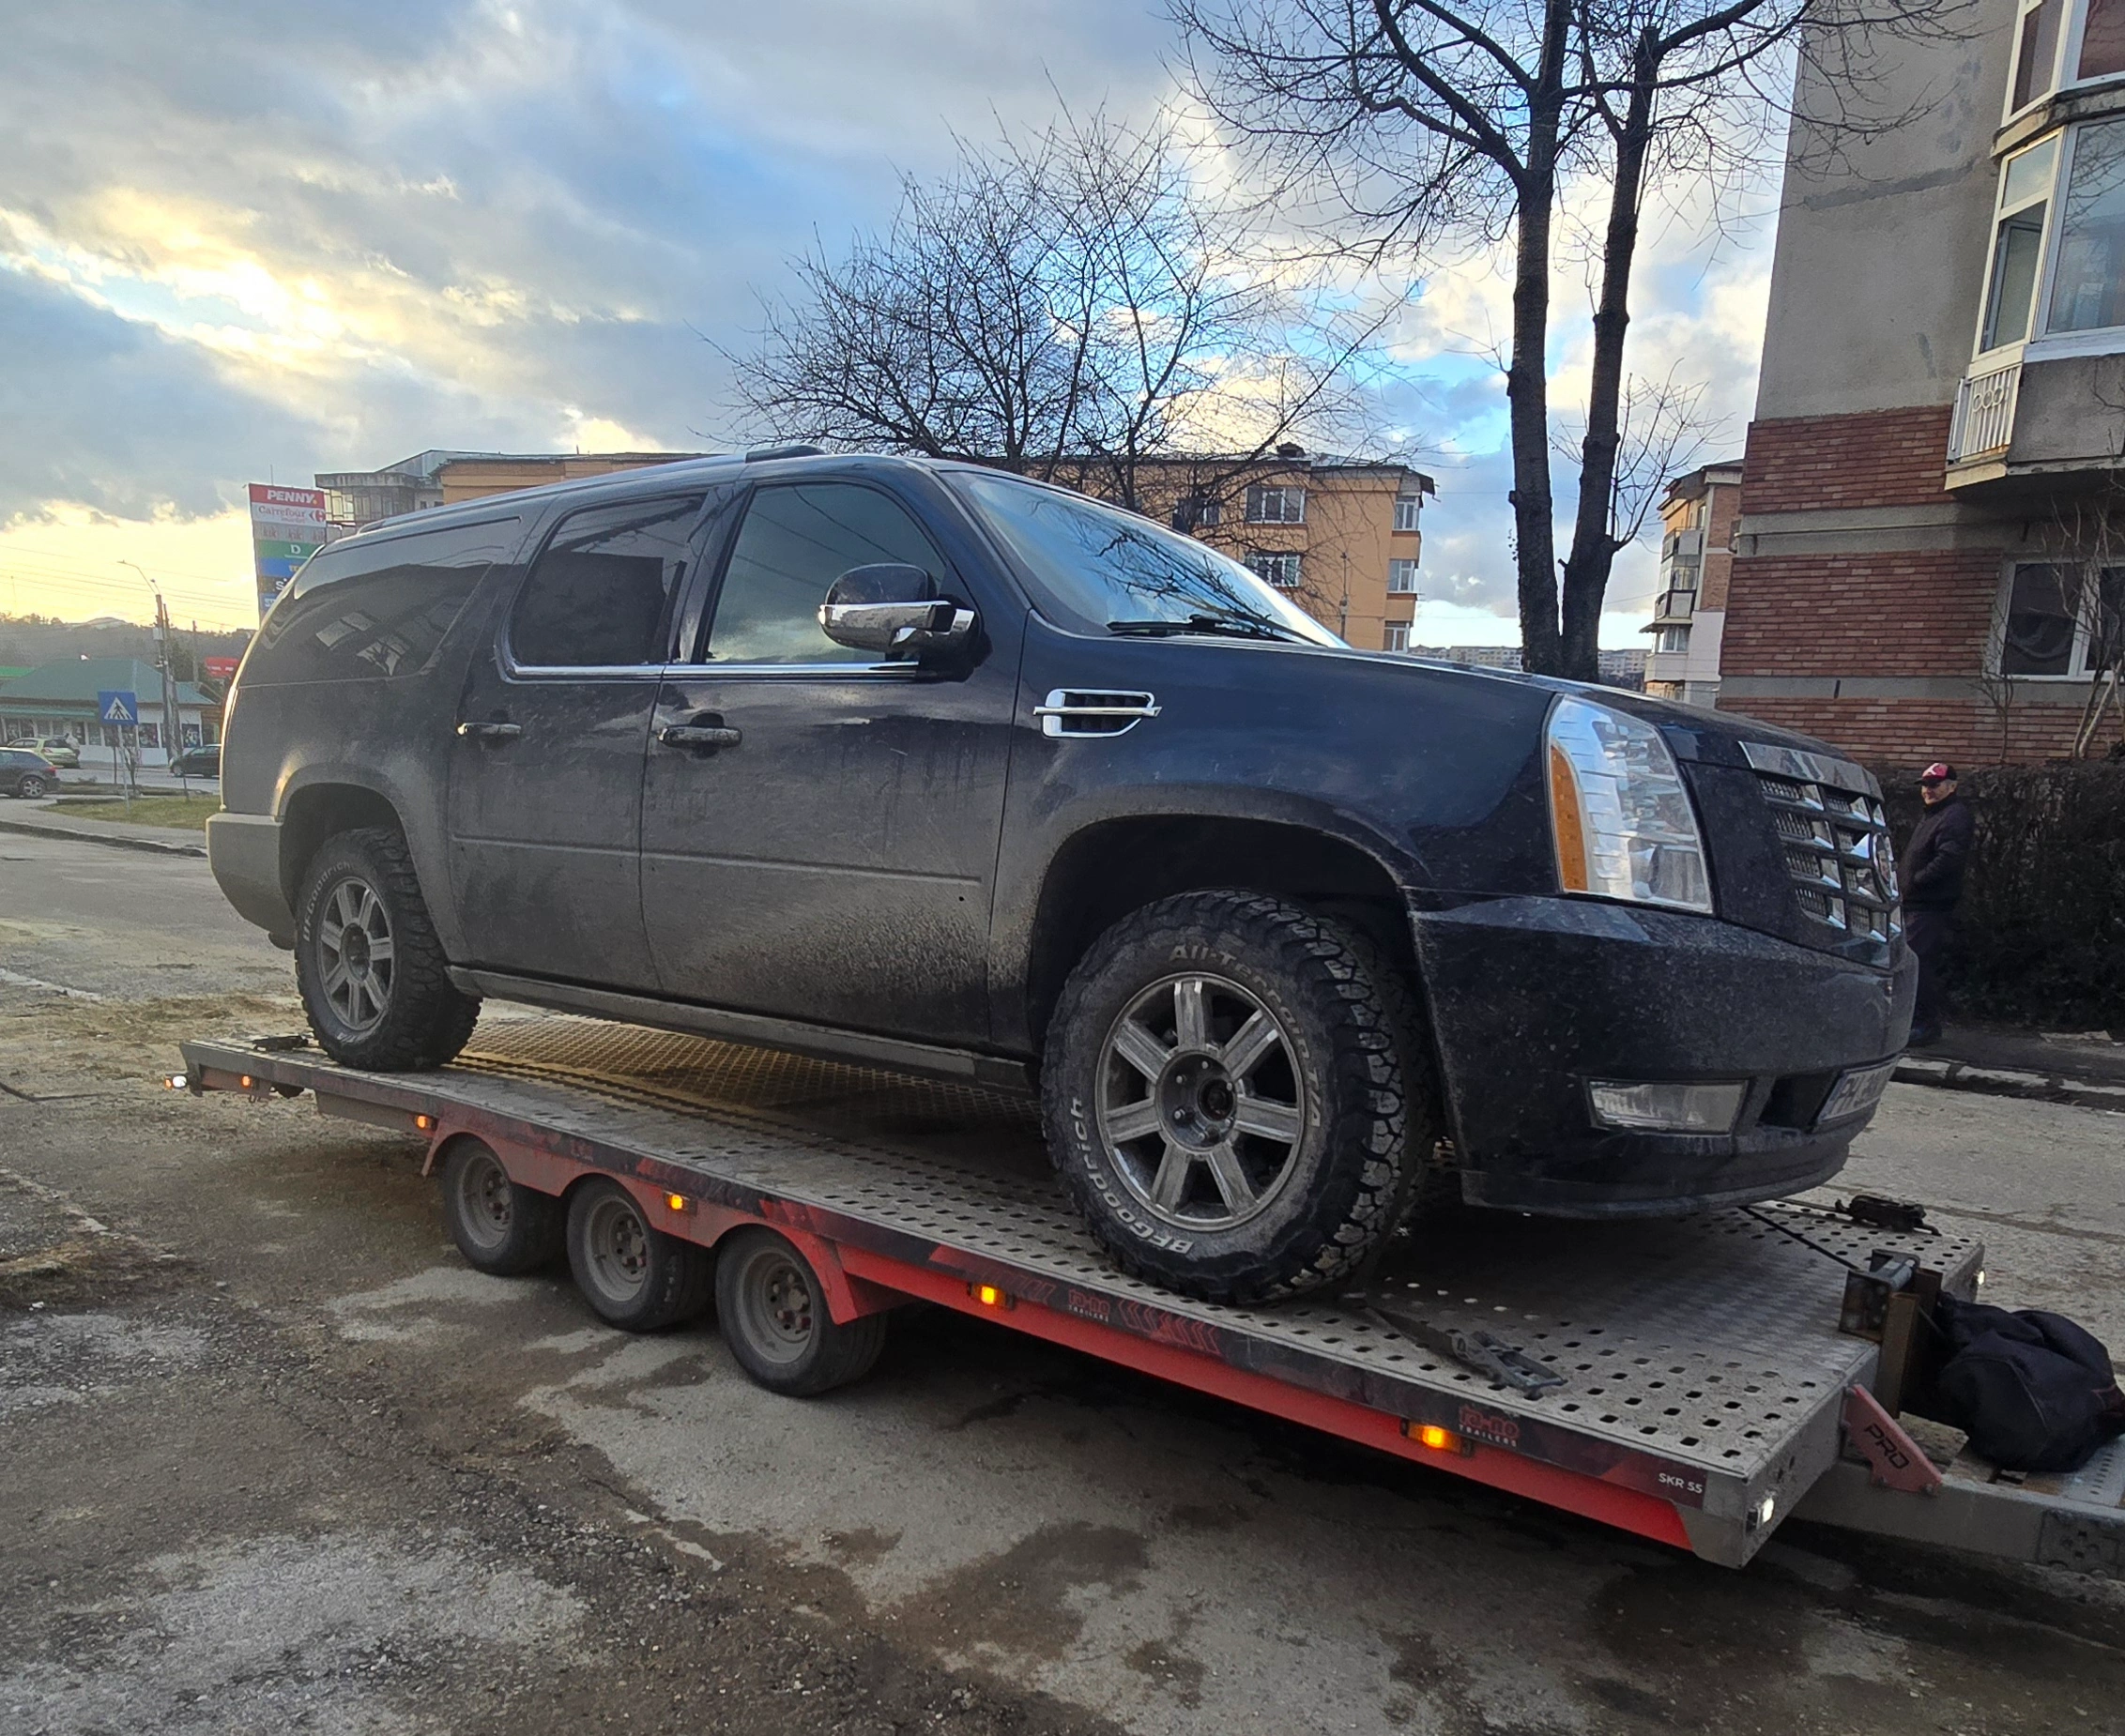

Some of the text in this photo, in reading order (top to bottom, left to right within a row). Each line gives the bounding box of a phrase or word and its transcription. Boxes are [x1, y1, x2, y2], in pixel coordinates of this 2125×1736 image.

[258, 506, 305, 518] Carrefour
[1070, 1097, 1194, 1254] BFGoodrich
[1459, 1424, 1517, 1447] TRAILERS
[1864, 1423, 1910, 1470] PRO
[1659, 1472, 1685, 1489] SKR
